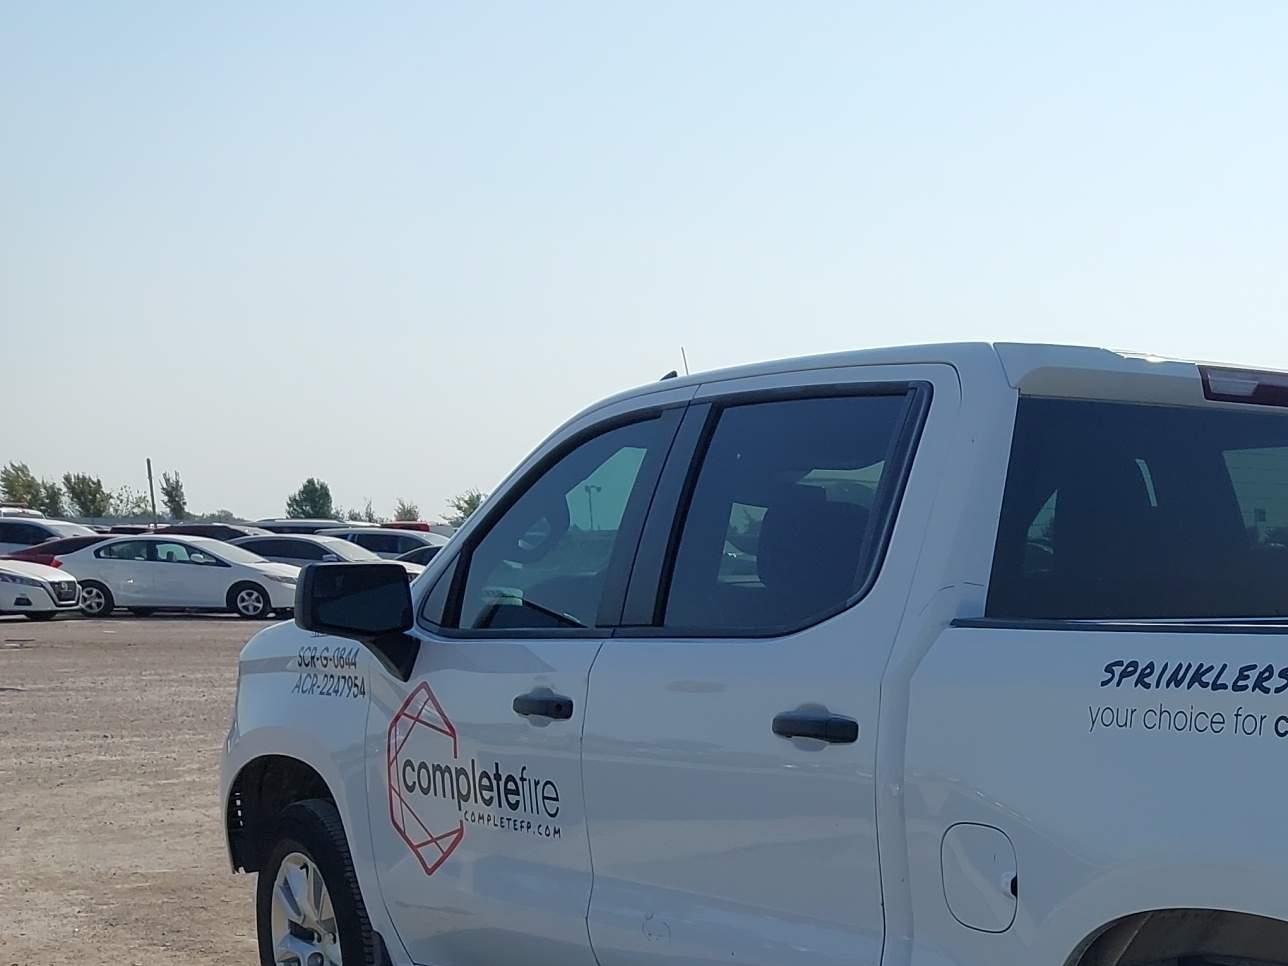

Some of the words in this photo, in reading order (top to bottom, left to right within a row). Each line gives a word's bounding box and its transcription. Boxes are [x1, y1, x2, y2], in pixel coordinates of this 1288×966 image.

[297, 646, 360, 669] SCR-G-0844
[291, 673, 366, 698] ACR-2247954
[1088, 705, 1137, 733] your
[1143, 704, 1225, 734] choice
[1233, 706, 1267, 737] for
[464, 810, 561, 839] COMPLETEFP.COM
